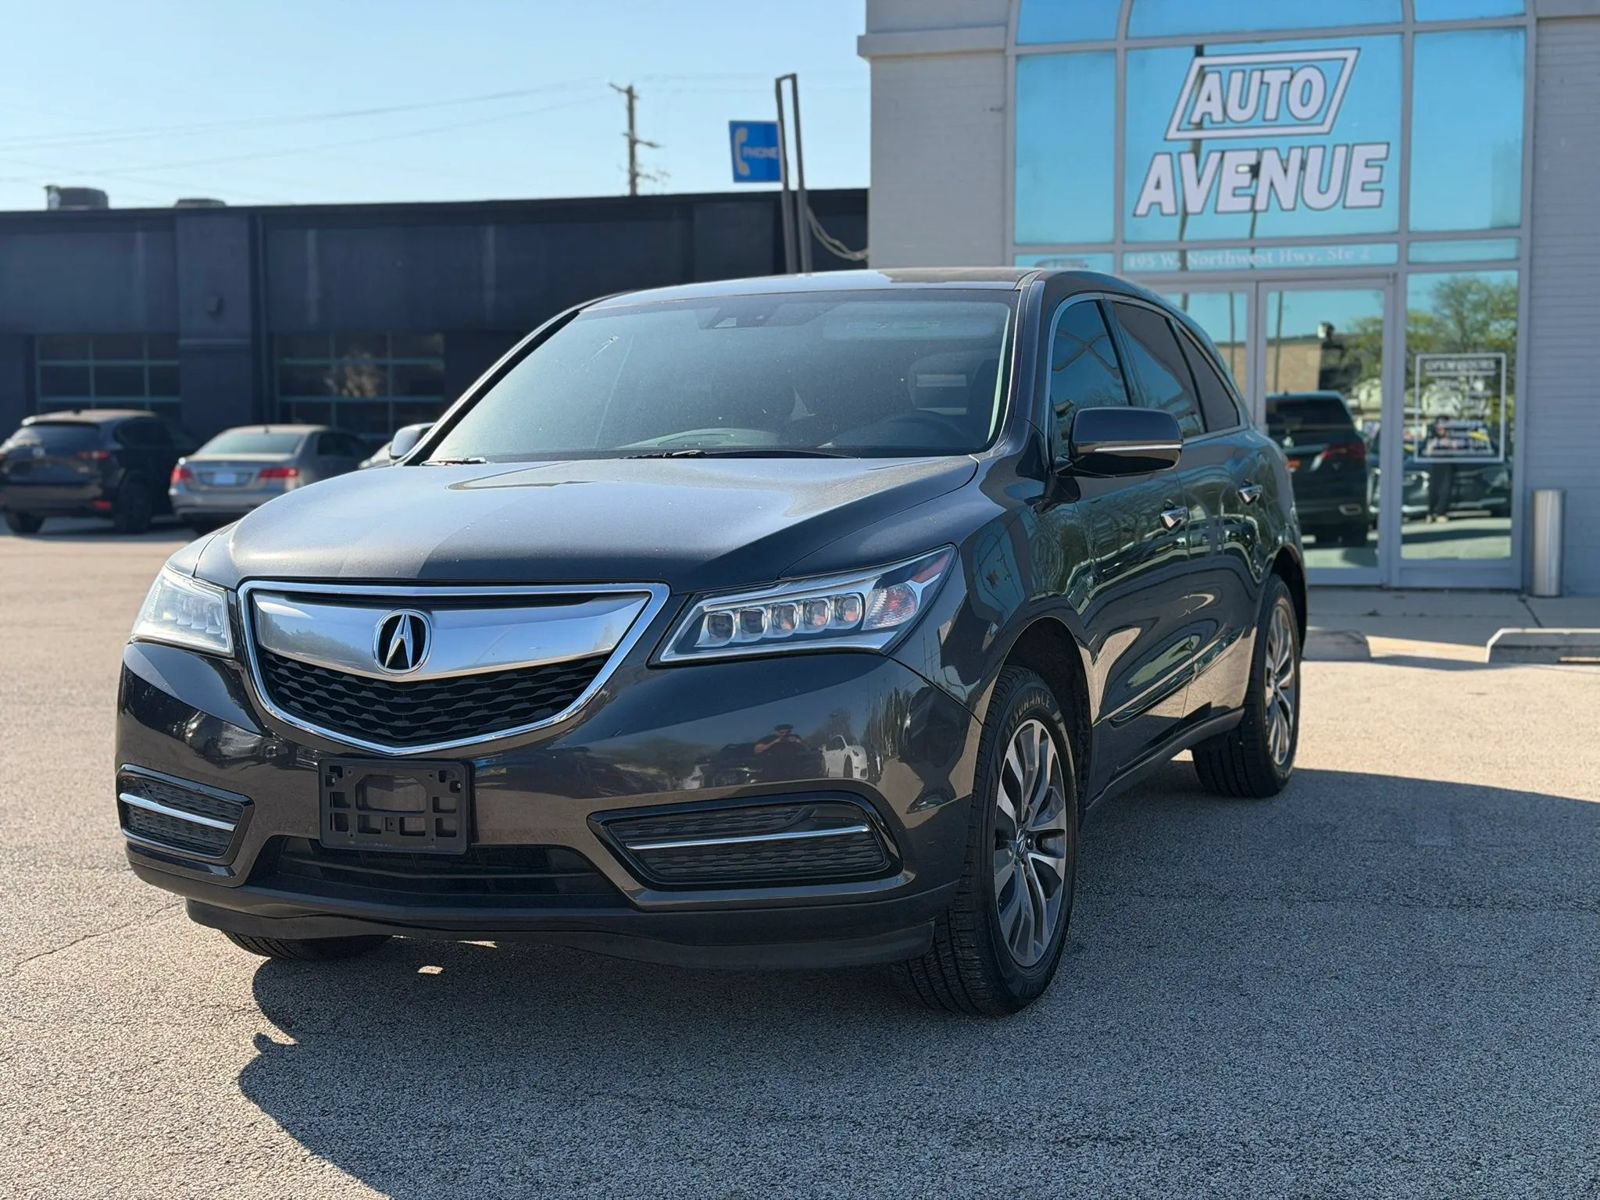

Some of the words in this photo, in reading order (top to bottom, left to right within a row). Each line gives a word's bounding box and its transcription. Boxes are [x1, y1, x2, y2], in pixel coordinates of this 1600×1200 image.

[1190, 65, 1327, 124] AUTO
[1133, 142, 1389, 216] AVENUE
[1187, 249, 1273, 267] Northwest
